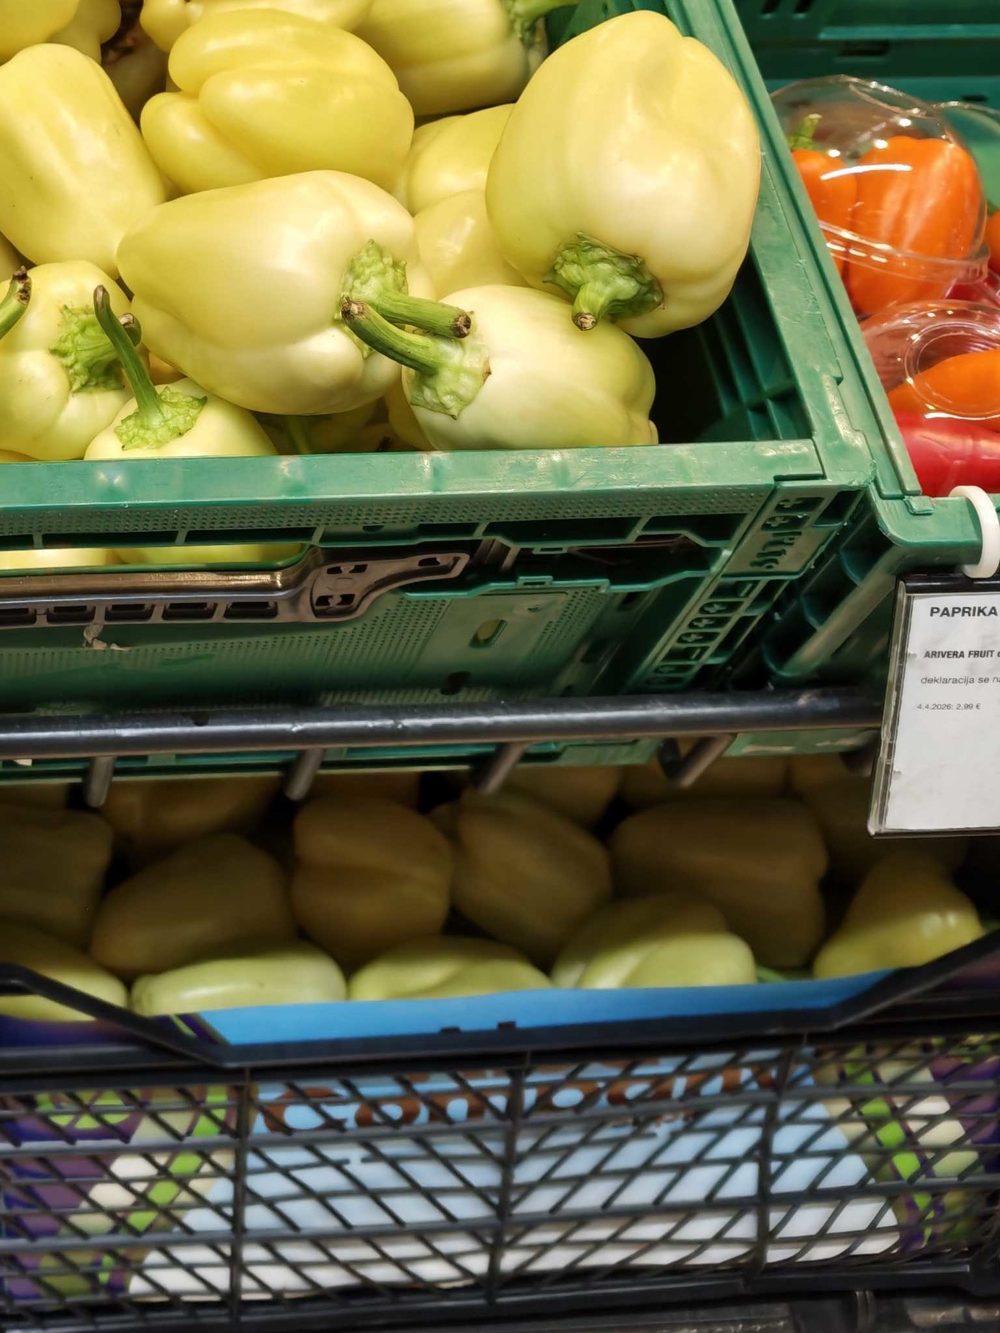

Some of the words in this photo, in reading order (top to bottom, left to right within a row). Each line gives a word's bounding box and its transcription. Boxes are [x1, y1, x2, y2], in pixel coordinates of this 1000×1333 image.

[929, 607, 998, 617] PAPRIKA
[923, 650, 965, 659] ARIVERA
[968, 650, 995, 658] FRUIT
[920, 676, 975, 686] deklaracija
[956, 703, 974, 711] 2,99
[975, 702, 982, 711] €
